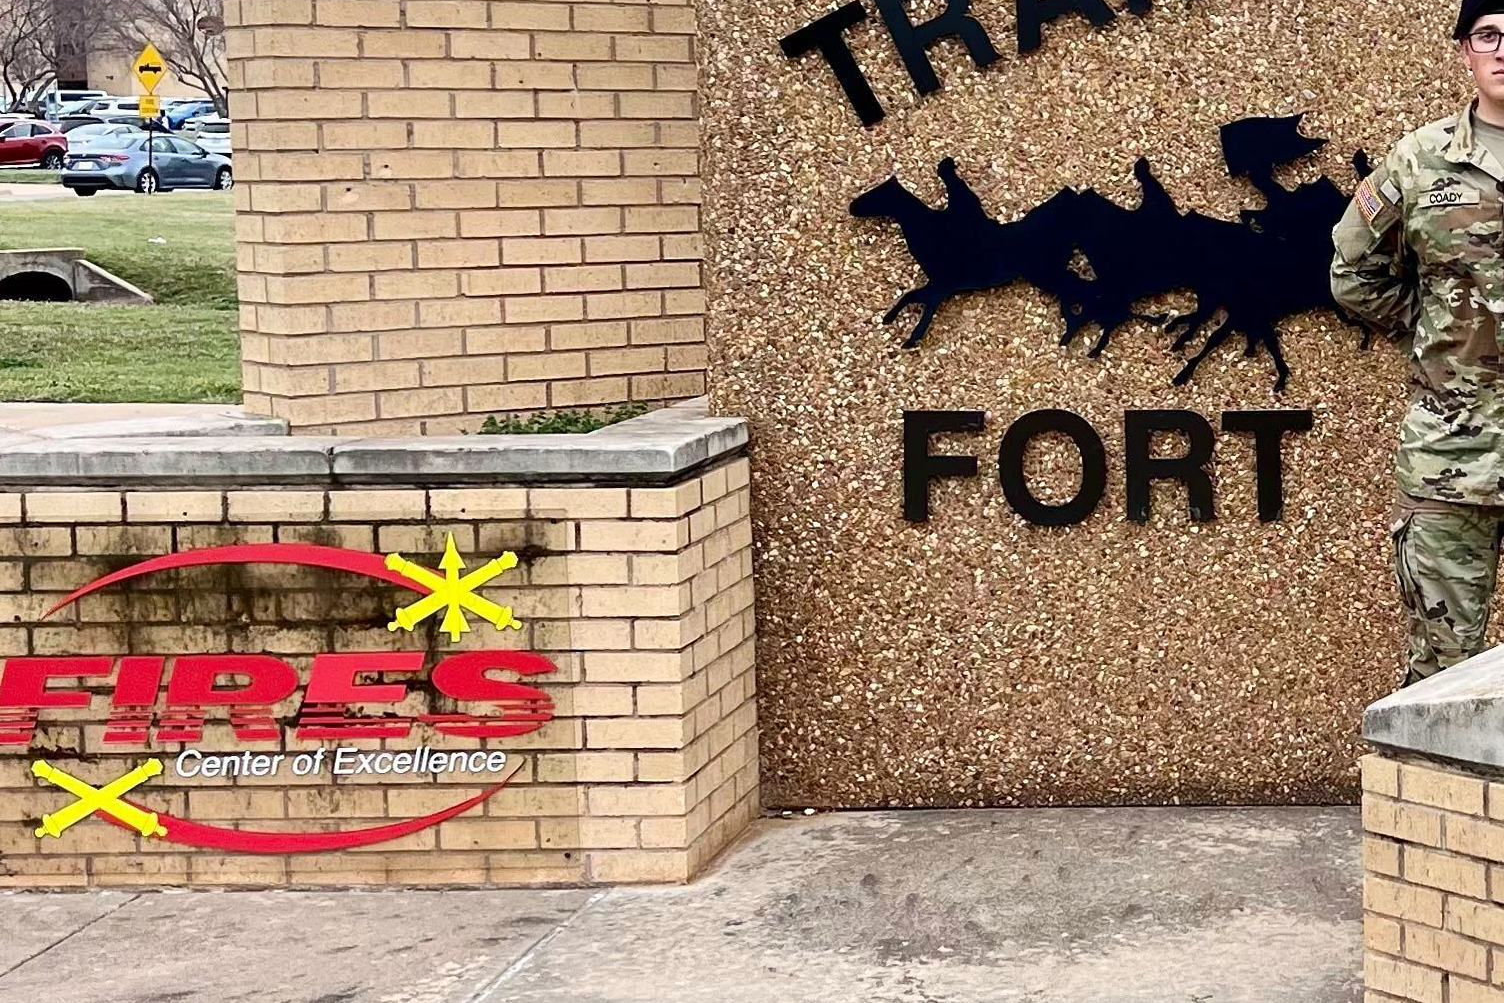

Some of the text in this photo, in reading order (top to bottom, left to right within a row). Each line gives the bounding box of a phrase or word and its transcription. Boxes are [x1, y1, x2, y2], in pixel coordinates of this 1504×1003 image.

[1429, 192, 1463, 204] COADY
[903, 409, 1313, 525] FORT
[0, 650, 558, 746] FIRES
[175, 746, 508, 778] Center of Excellence
